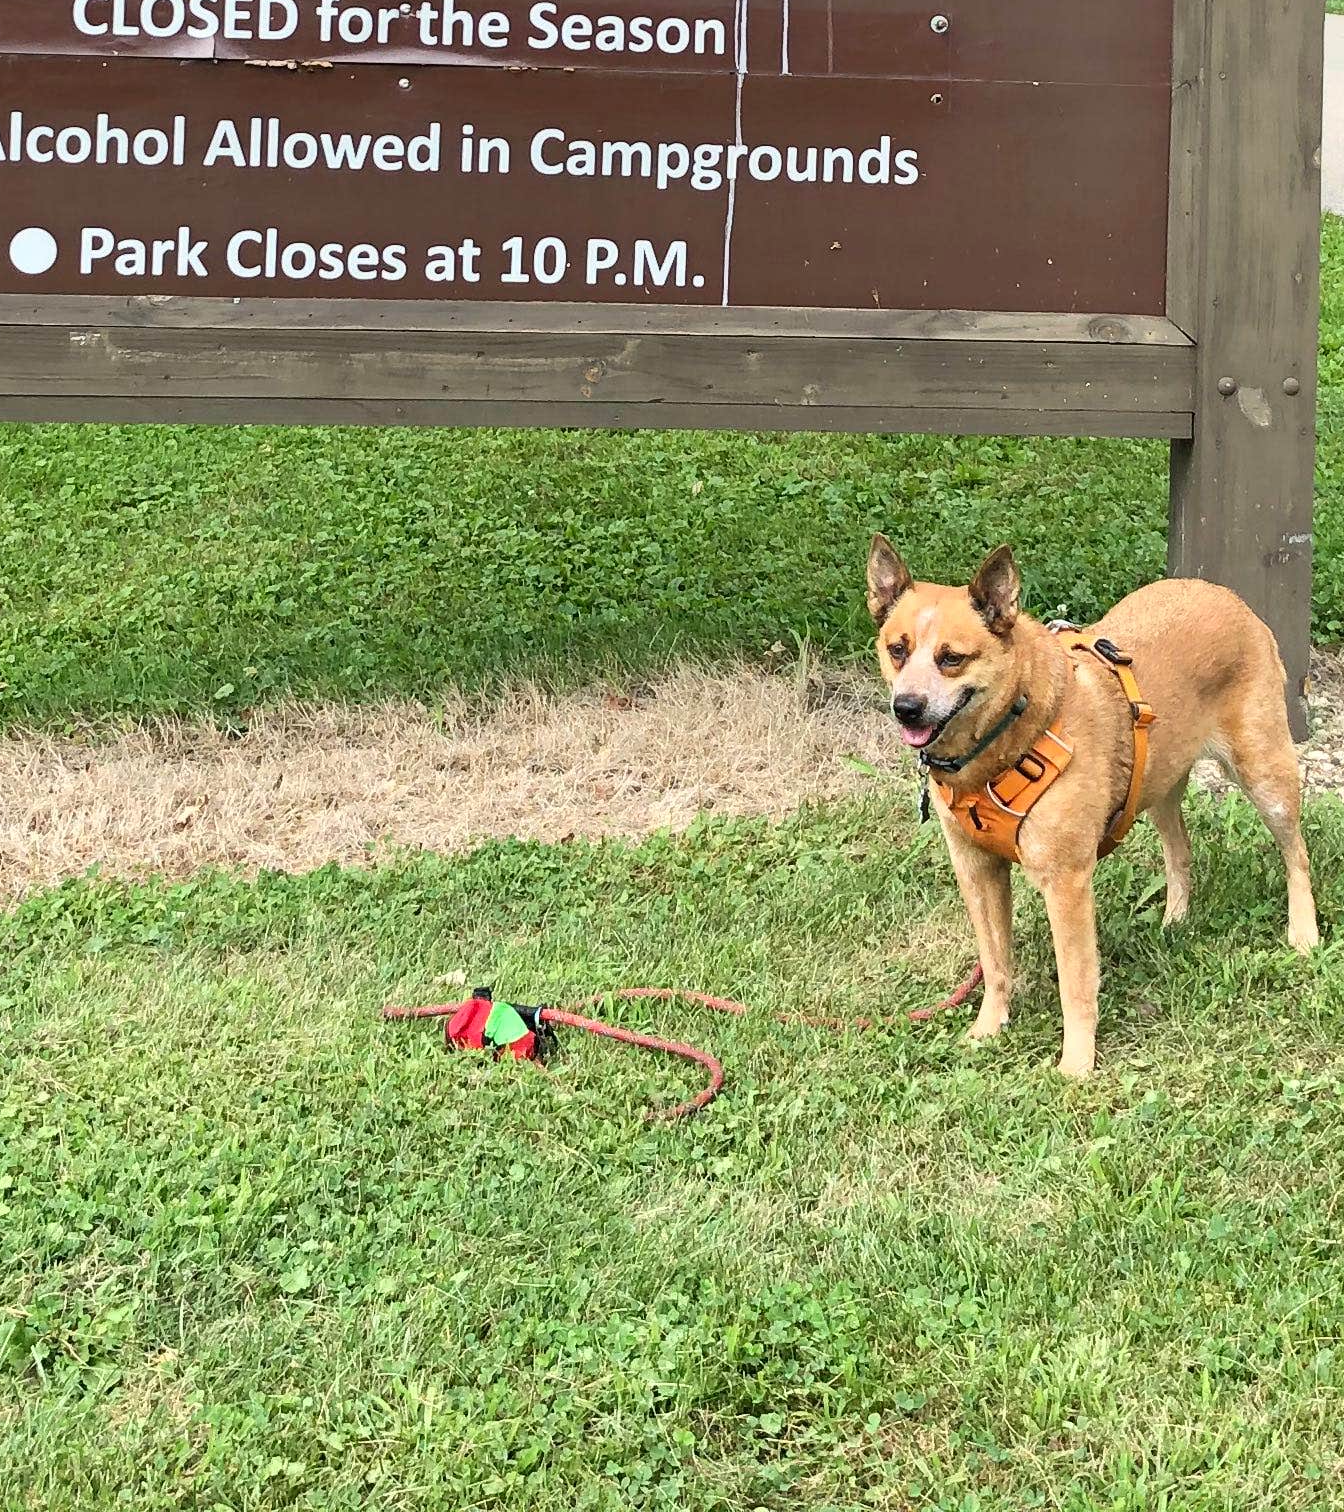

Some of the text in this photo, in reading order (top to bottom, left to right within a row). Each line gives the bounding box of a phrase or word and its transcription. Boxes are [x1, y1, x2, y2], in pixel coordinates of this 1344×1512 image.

[528, 2, 724, 54] Season
[203, 118, 440, 171] Allowed
[462, 125, 509, 173] in
[531, 129, 918, 190] Campgrounds
[81, 227, 704, 287] Park Closes at 10 P.M.
